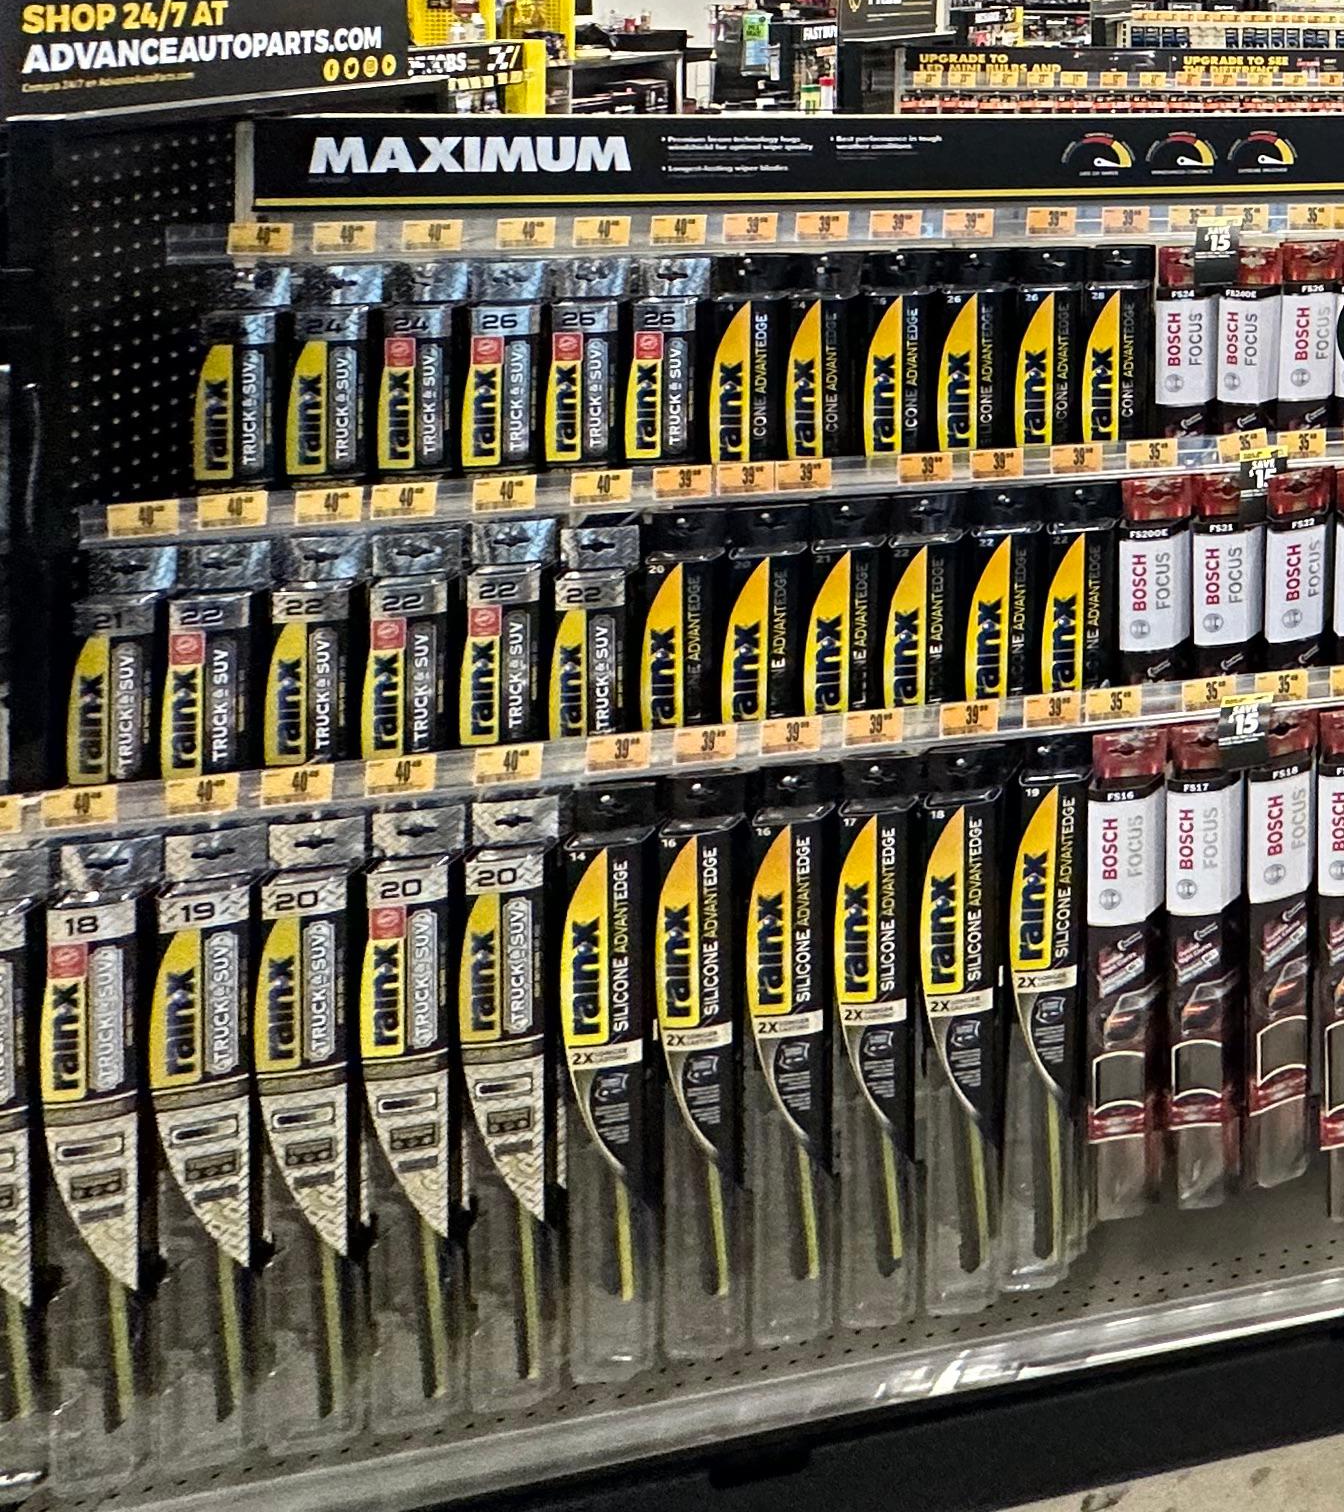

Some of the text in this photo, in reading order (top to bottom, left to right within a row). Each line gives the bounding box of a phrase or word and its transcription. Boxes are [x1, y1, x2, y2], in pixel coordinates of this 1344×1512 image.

[22, 4, 117, 33] SHOP
[191, 0, 228, 27] AT
[22, 26, 382, 75] ADVANCEAUTOPARTS.COM
[919, 54, 1008, 63] UPGRADE TO
[1183, 56, 1289, 65] UPGRADE TO SEE
[309, 136, 631, 174] MAXIMUM
[1189, 312, 1203, 366] FOCUS
[1209, 524, 1233, 533] FS21
[1291, 519, 1315, 528] FS22
[1132, 554, 1147, 612] BOSCH
[1155, 552, 1170, 610] FOCUS
[1273, 766, 1299, 780] FS18
[1107, 791, 1134, 801] FS16
[930, 810, 945, 820] 18
[757, 827, 771, 837] 16
[569, 852, 586, 862] 14
[1103, 817, 1118, 880] BOSCH
[1128, 815, 1145, 878] FOCUS
[379, 878, 423, 900] 20
[795, 834, 812, 927] ADVANTEDGE
[180, 901, 215, 922] 19
[64, 914, 98, 936] 18
[613, 955, 630, 1033] SILICONE
[312, 989, 329, 1053] TRUCK
[757, 1020, 779, 1034] 2X
